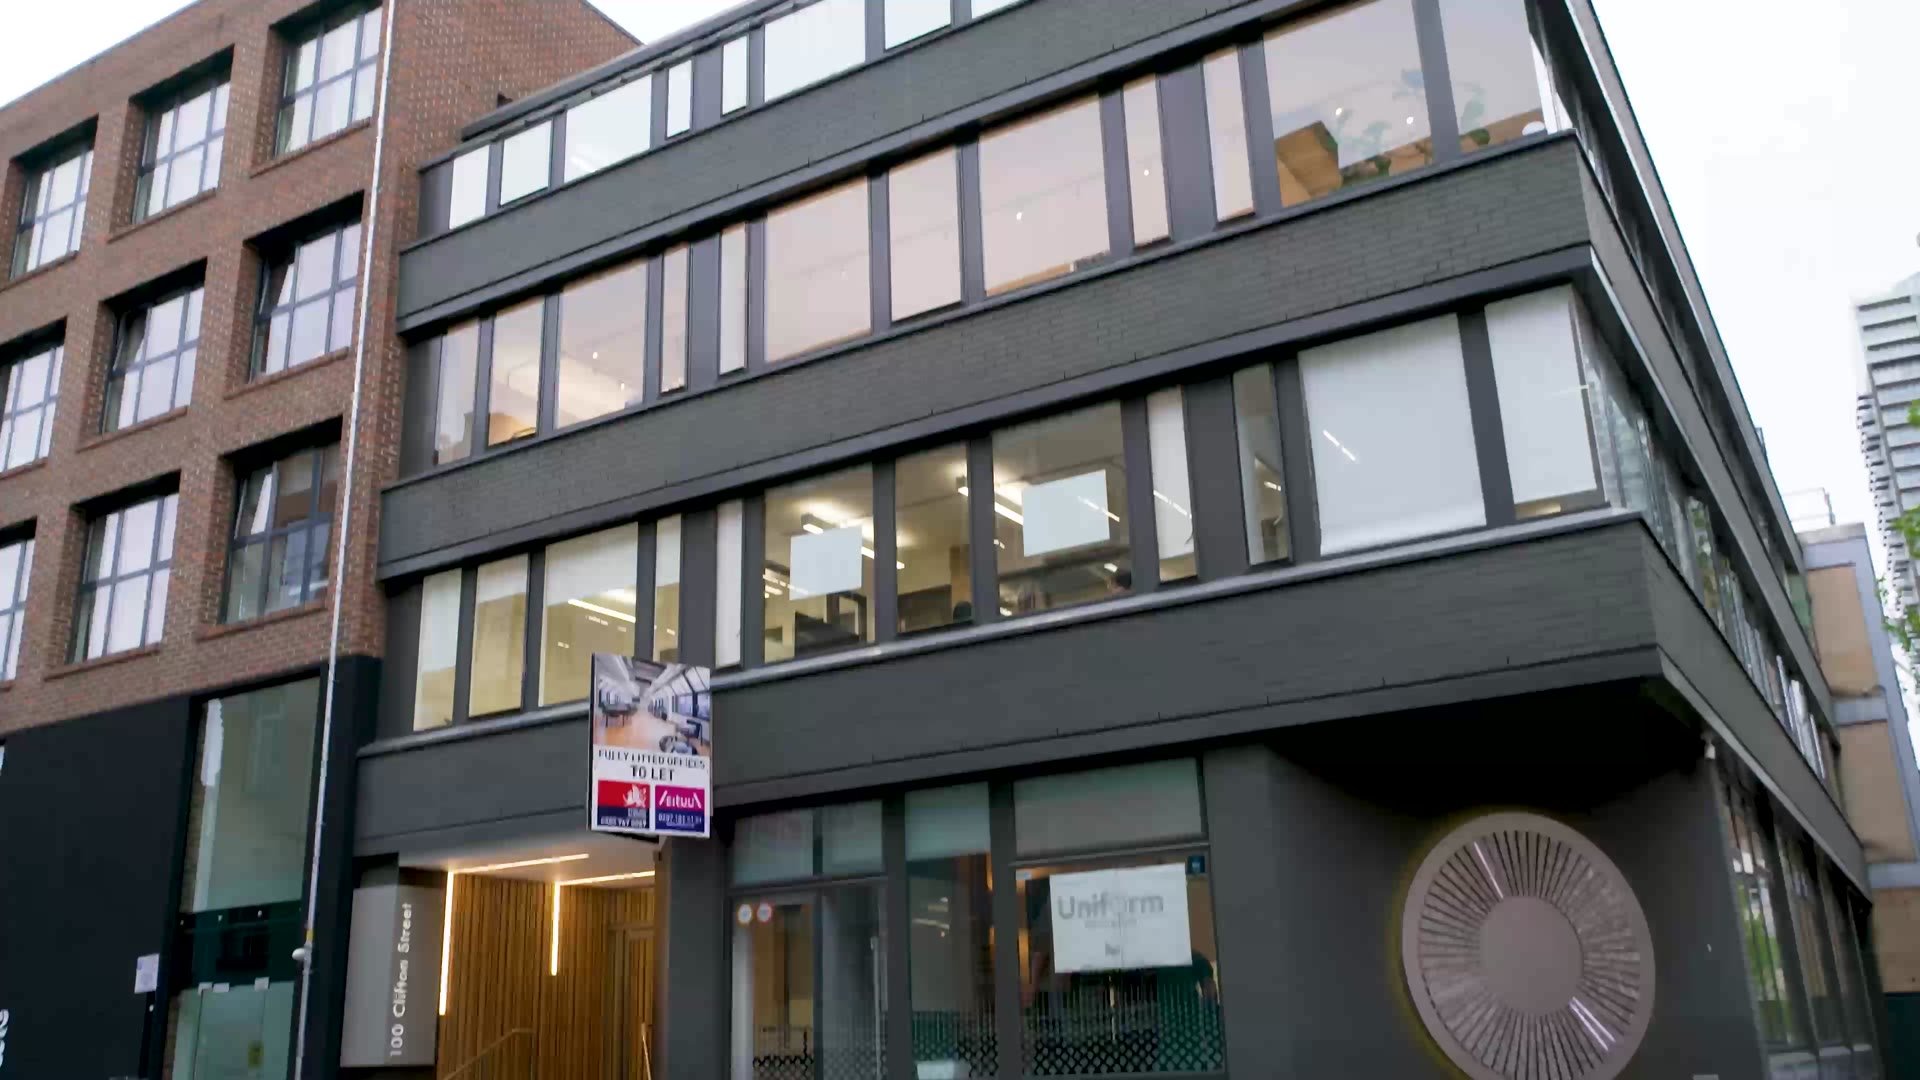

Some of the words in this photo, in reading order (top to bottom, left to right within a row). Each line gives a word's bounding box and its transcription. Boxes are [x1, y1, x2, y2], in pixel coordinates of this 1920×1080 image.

[630, 764, 647, 779] TO
[651, 767, 675, 781] LET
[398, 903, 412, 953] Street
[393, 959, 409, 1018] Clifton
[390, 1023, 404, 1056] 100
